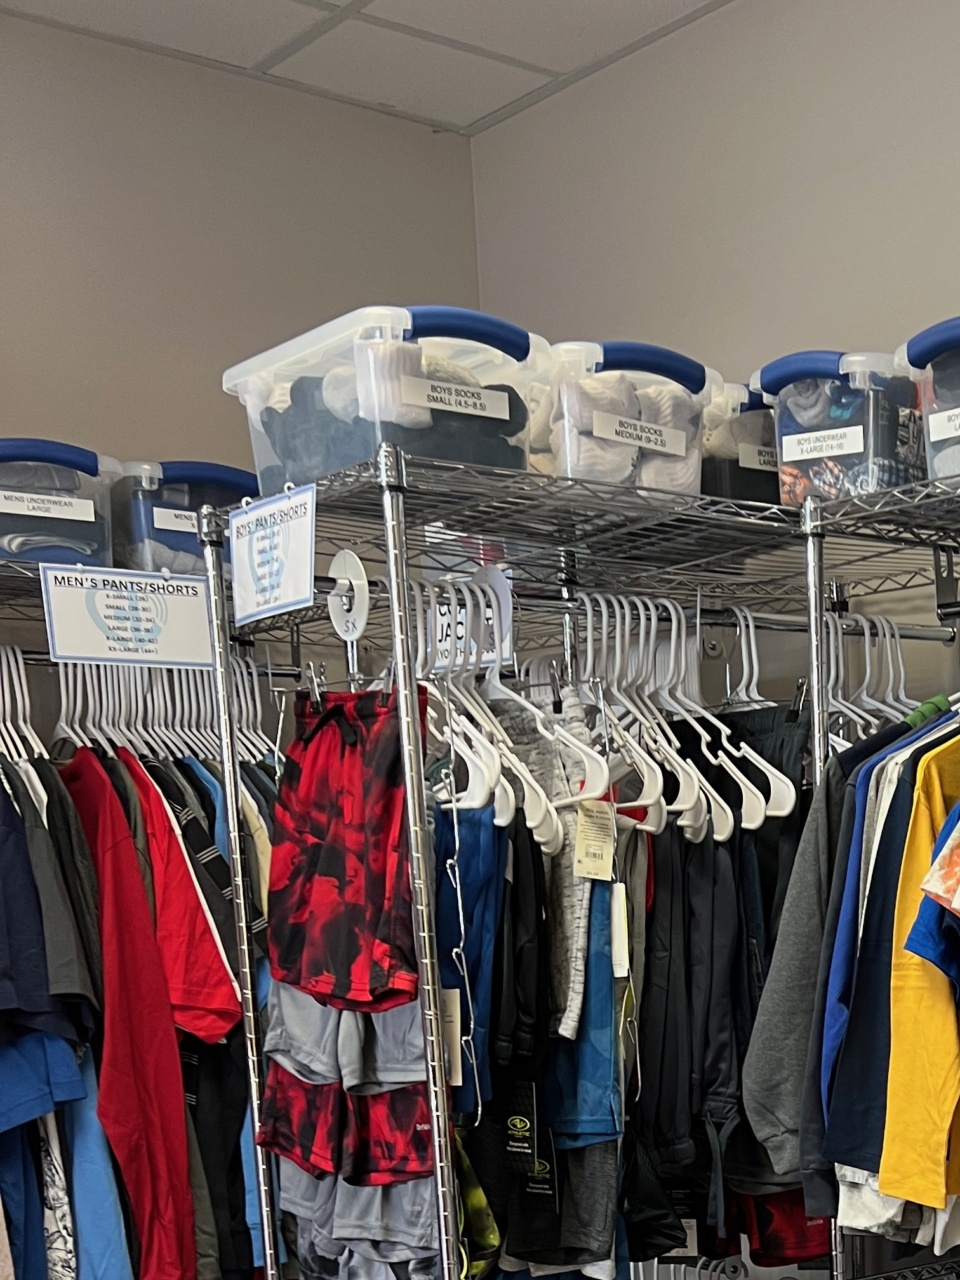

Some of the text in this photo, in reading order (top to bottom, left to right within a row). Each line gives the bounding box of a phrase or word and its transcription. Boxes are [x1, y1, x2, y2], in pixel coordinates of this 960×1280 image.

[430, 384, 482, 401] BOYS SOCKS
[426, 394, 453, 407] SMALL
[614, 428, 643, 442] MEDIUM
[618, 420, 663, 438] BOYS SOCKS
[797, 432, 848, 446] BOYS UNDERWEAR
[757, 448, 775, 460] BOYS
[800, 443, 825, 455] X-LARGE
[3, 494, 74, 508] MENS UNDERWEAR
[26, 504, 52, 513] LARGE
[173, 512, 193, 522] MENS
[235, 520, 255, 539] BOYS'
[254, 502, 308, 531] PANTS/SHORTS
[53, 574, 200, 597] MEN'S PANTS/SHORTS
[105, 593, 134, 602] X-SMALL
[105, 603, 127, 612] SMALL
[103, 614, 131, 622] MEDIUM
[107, 625, 129, 633] LARGE
[106, 635, 134, 643] X-LARGE
[108, 646, 140, 654] XX-LARGE
